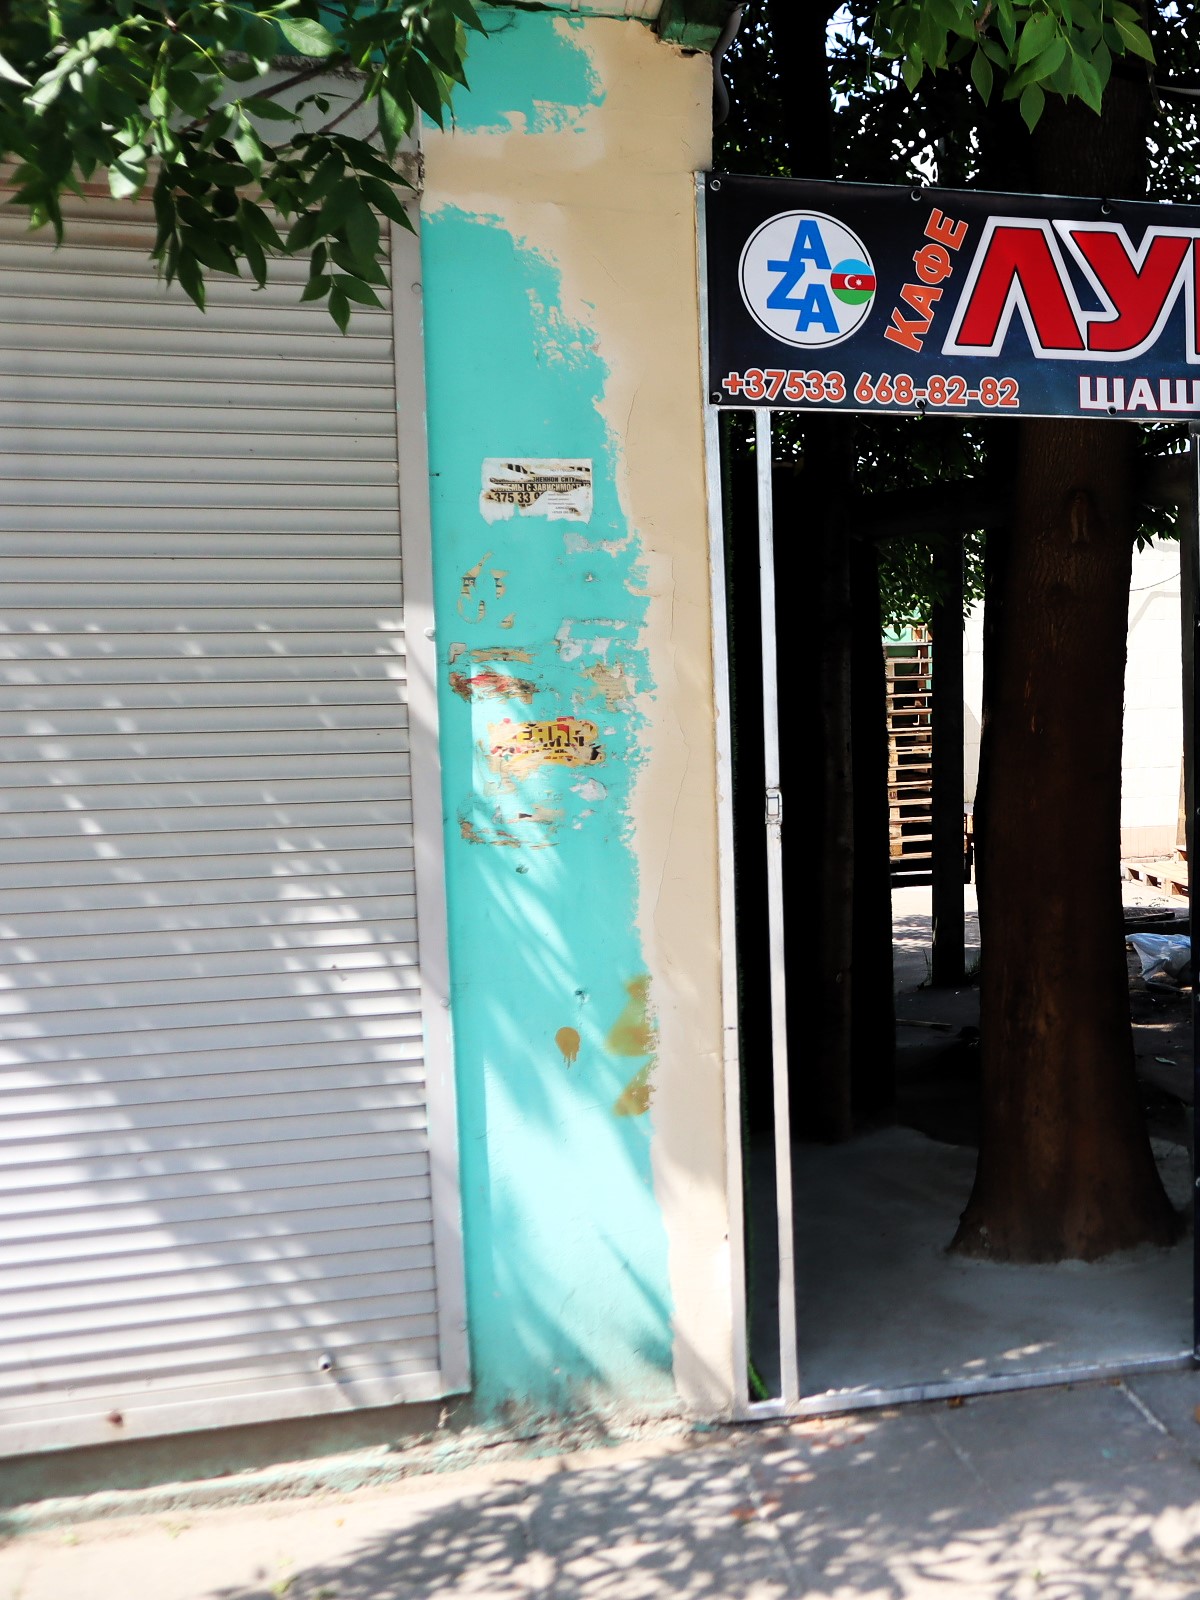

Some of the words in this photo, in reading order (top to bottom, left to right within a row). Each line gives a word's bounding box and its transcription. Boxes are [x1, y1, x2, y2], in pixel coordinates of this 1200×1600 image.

[884, 208, 969, 353] КАФЕ
[722, 368, 847, 402] +37533
[853, 372, 1020, 408] 668-82-82
